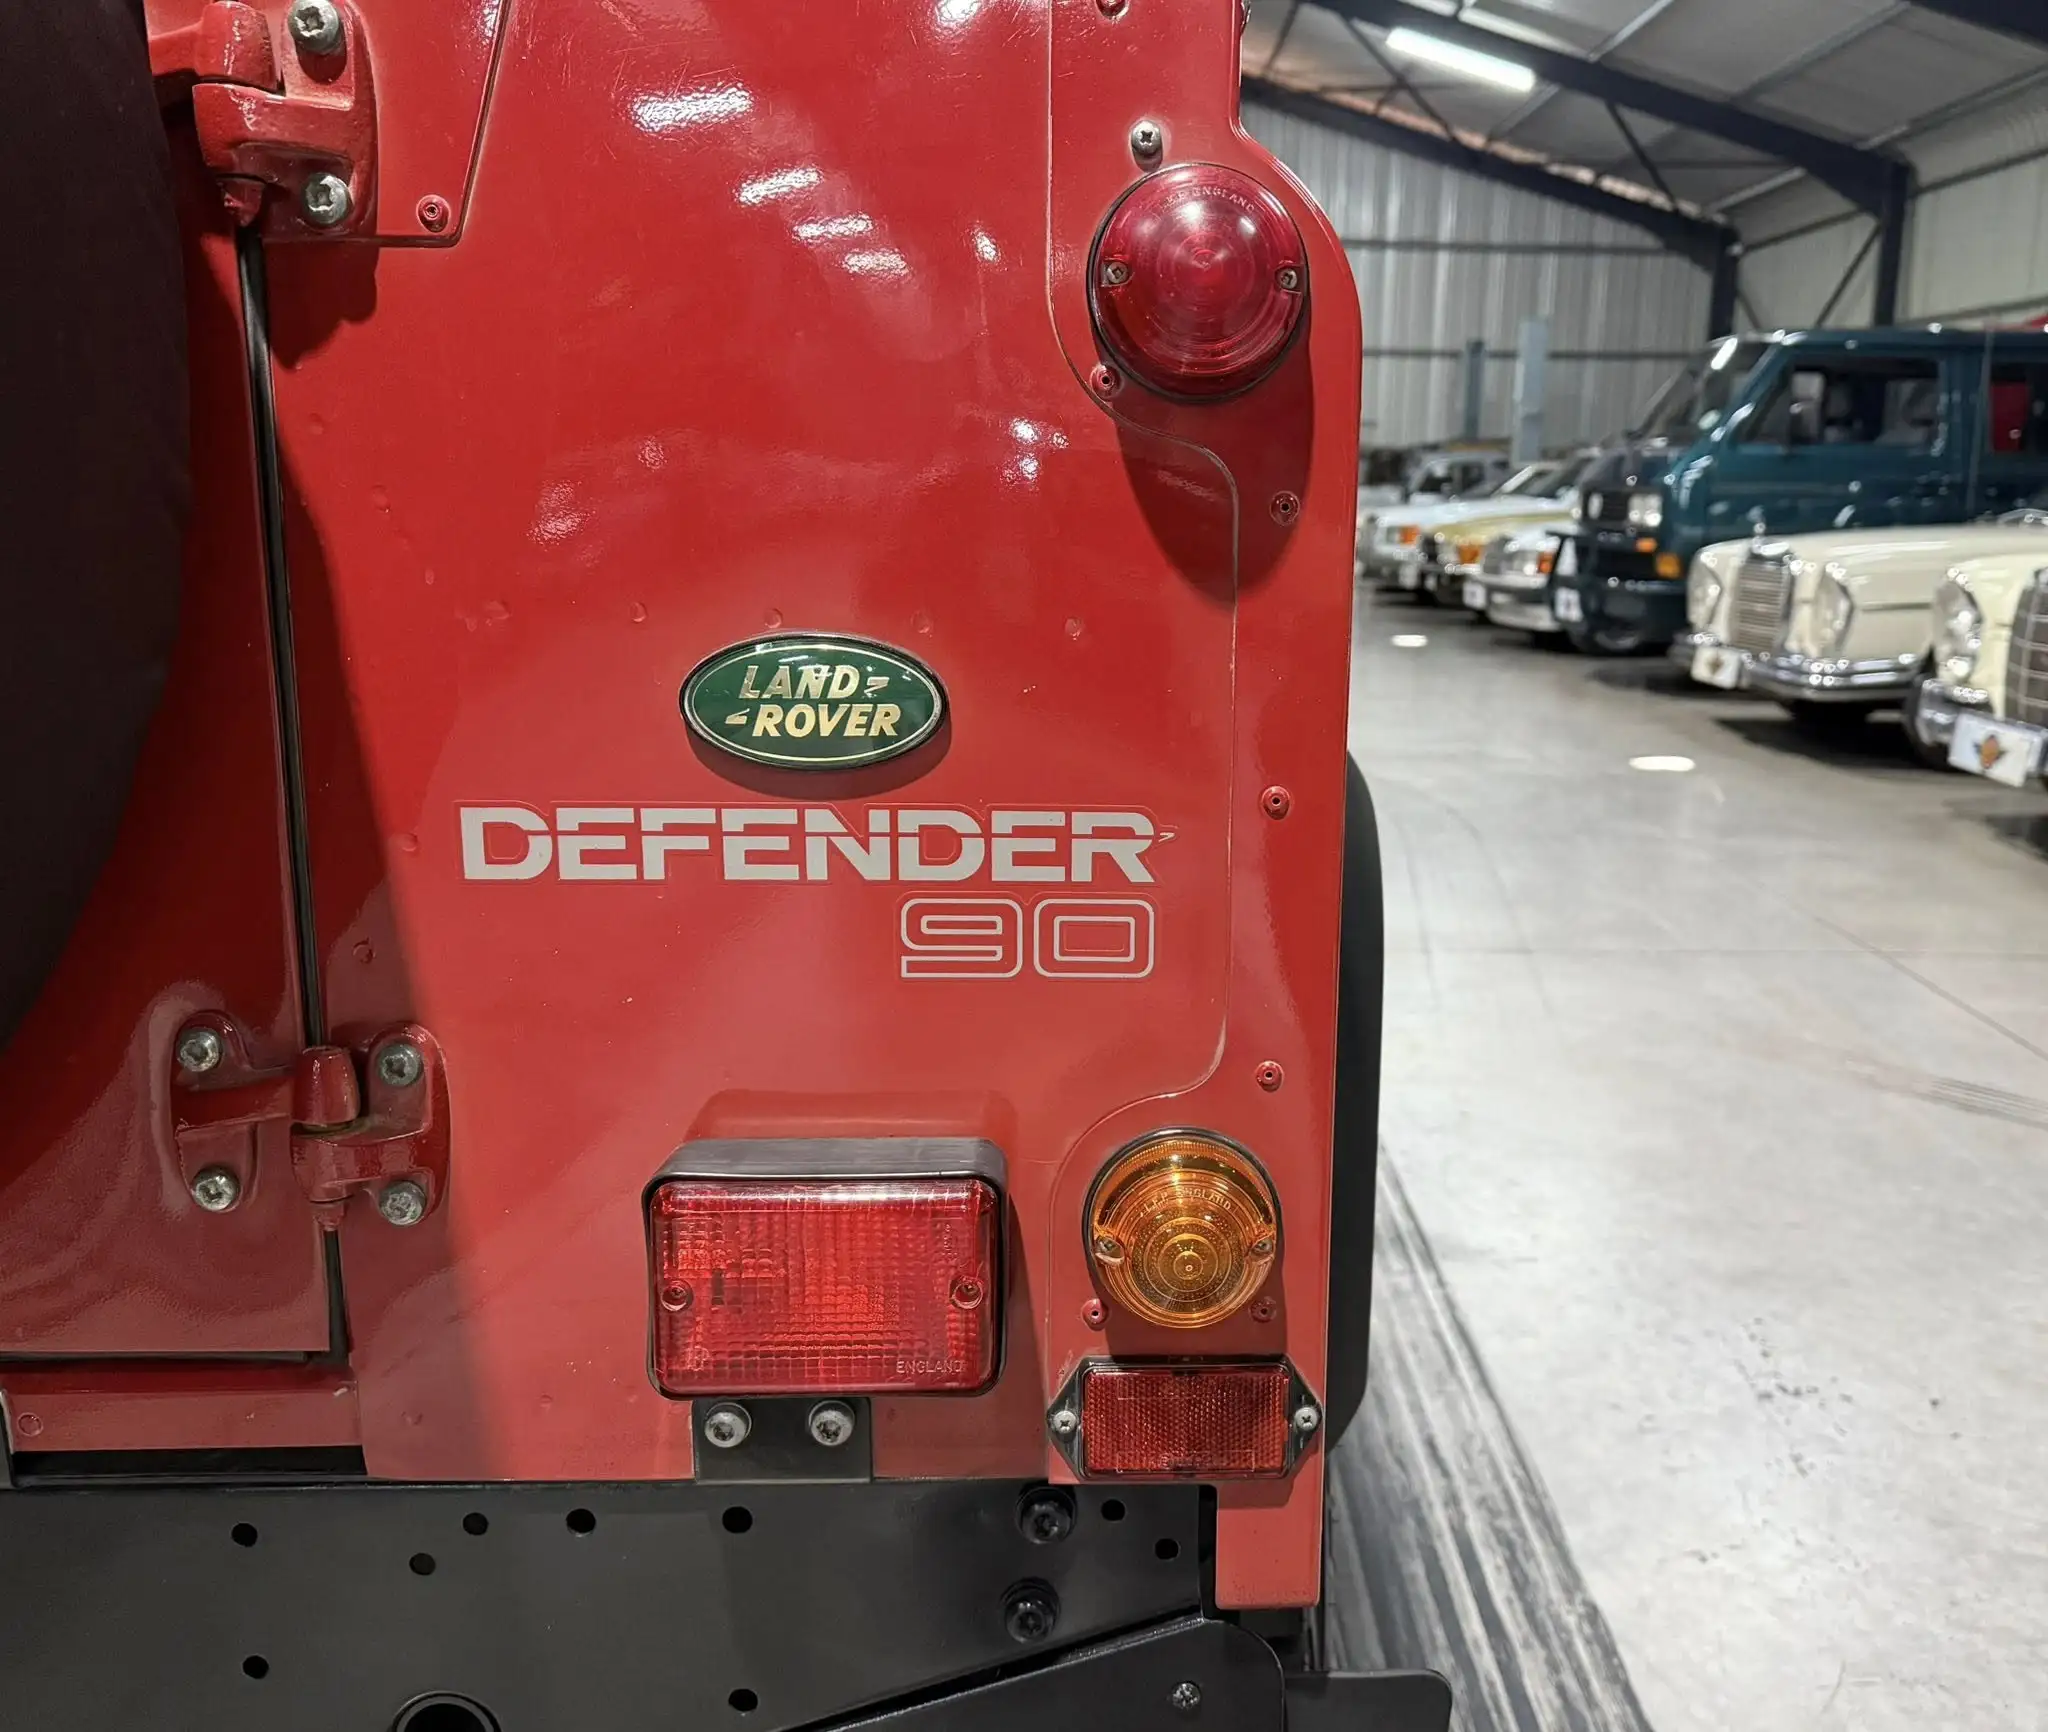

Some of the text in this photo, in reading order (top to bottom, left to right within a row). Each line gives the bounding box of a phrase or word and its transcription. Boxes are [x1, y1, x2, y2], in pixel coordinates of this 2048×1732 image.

[738, 664, 860, 699] LAND
[751, 703, 901, 738] ROVER
[460, 806, 1156, 883] DEFENDER
[900, 898, 1154, 978] 90
[895, 1360, 962, 1375] ENGLAND
